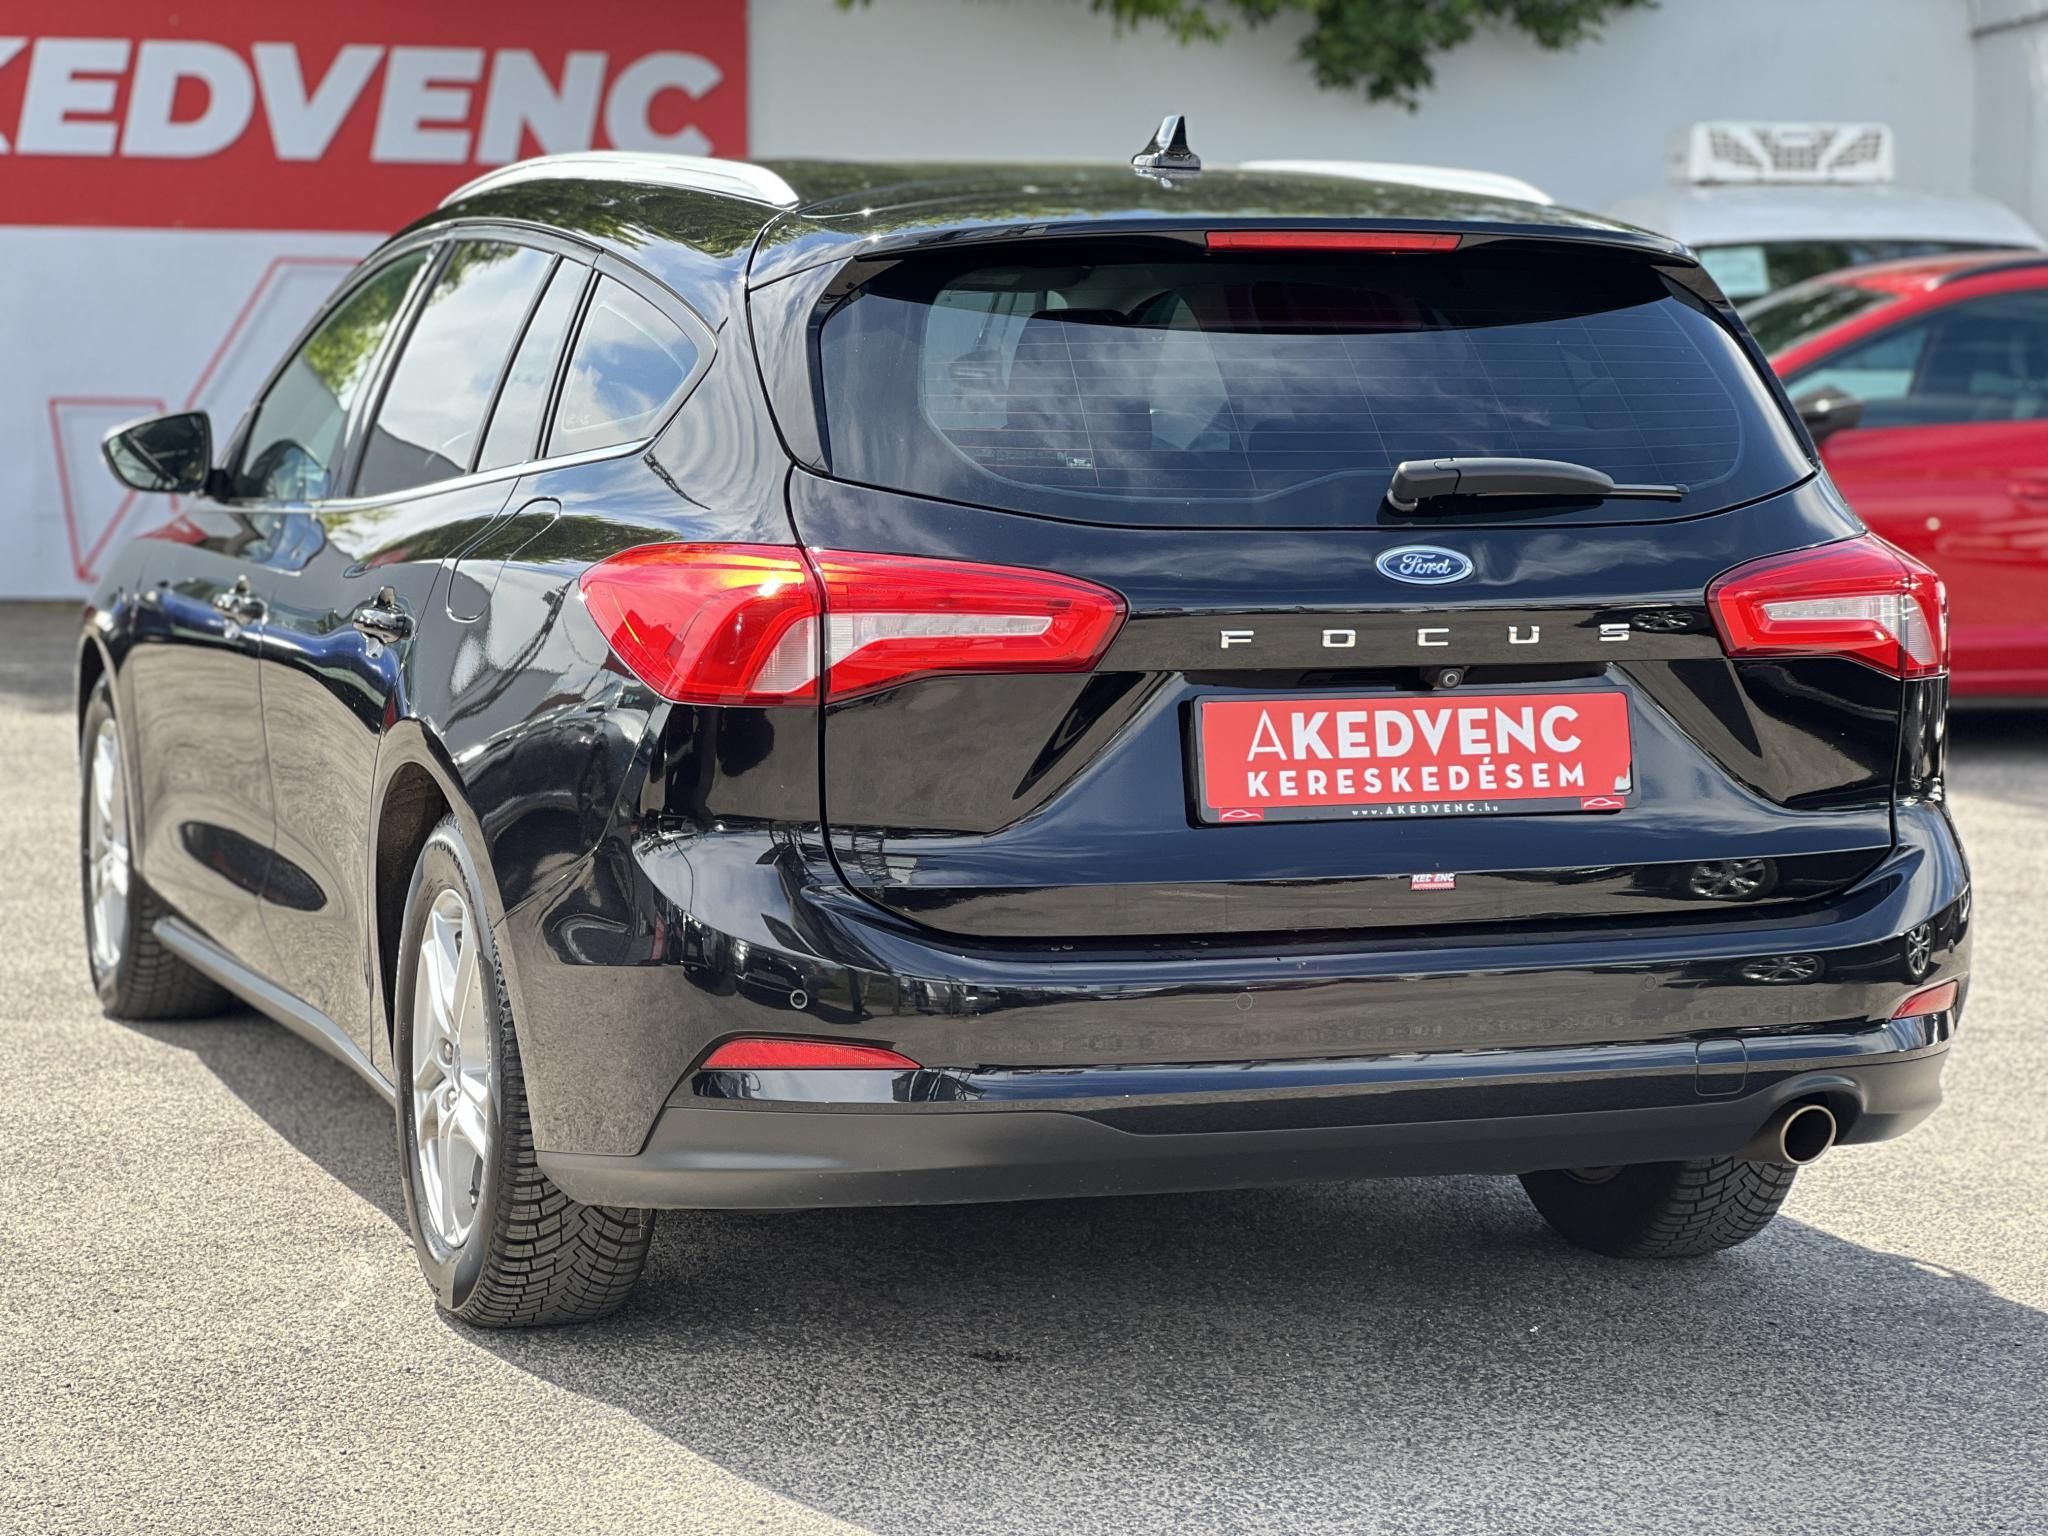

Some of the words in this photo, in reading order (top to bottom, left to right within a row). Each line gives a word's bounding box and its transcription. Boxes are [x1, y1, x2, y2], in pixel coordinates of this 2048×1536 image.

[0, 36, 723, 165] EDVENC
[1400, 553, 1451, 575] Ford
[1220, 624, 1630, 648] FOCUS
[1247, 757, 1585, 798] KERESKEDÉSEM
[1352, 802, 1499, 816] www.AKEDVENC.hu
